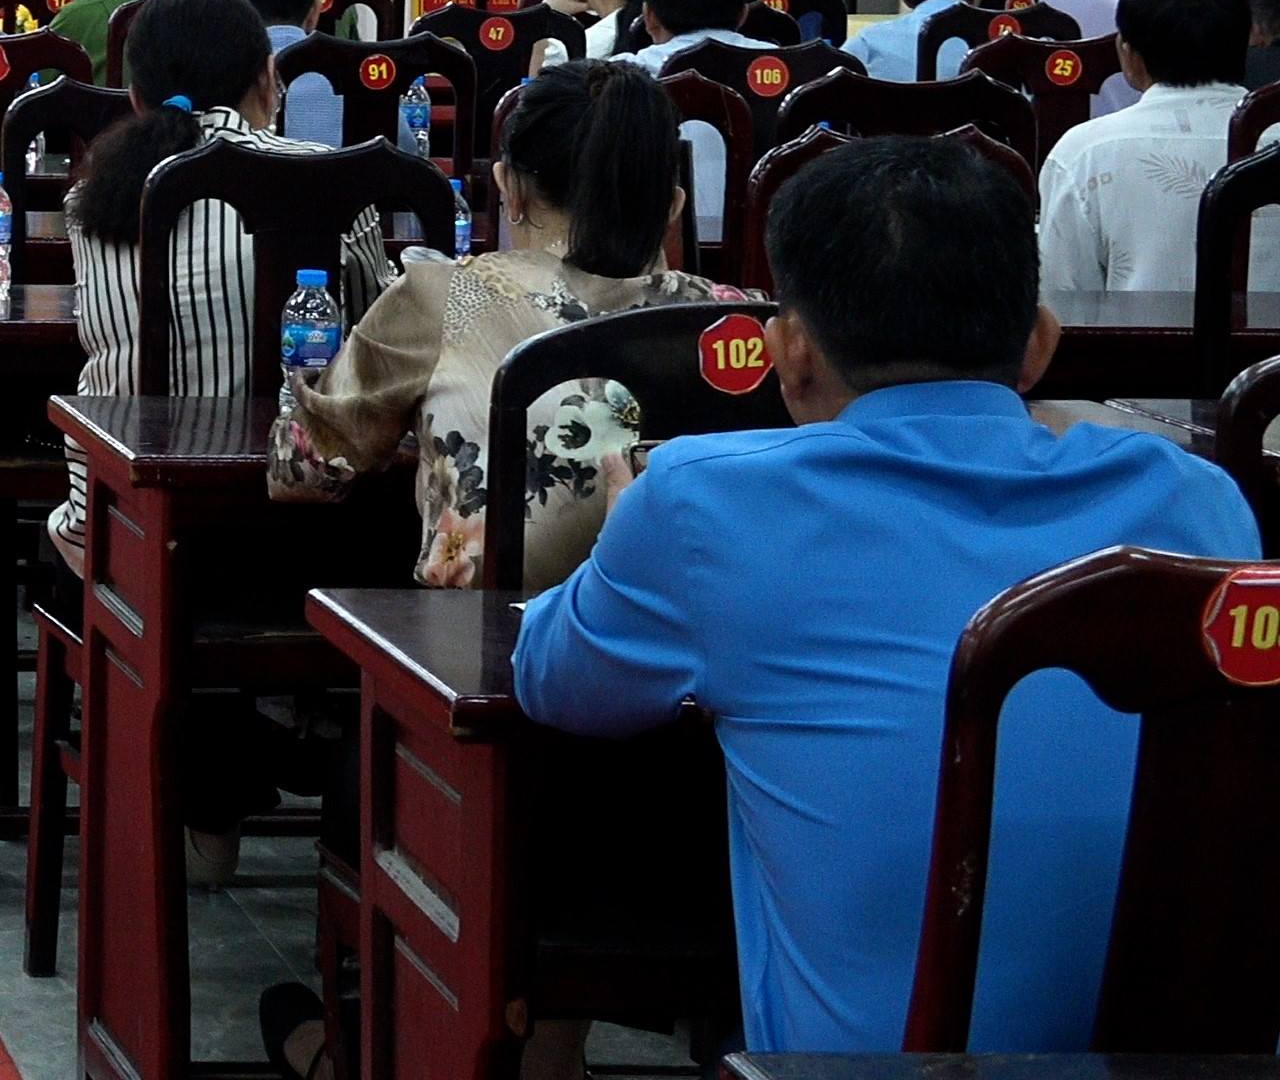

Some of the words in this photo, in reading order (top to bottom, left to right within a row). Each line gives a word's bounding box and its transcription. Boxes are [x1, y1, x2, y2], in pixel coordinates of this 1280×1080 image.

[488, 27, 505, 42] 47
[368, 61, 388, 80] 91
[755, 67, 782, 86] 106
[1053, 59, 1075, 77] 25
[712, 337, 765, 370] 102
[1229, 604, 1280, 649] 10
